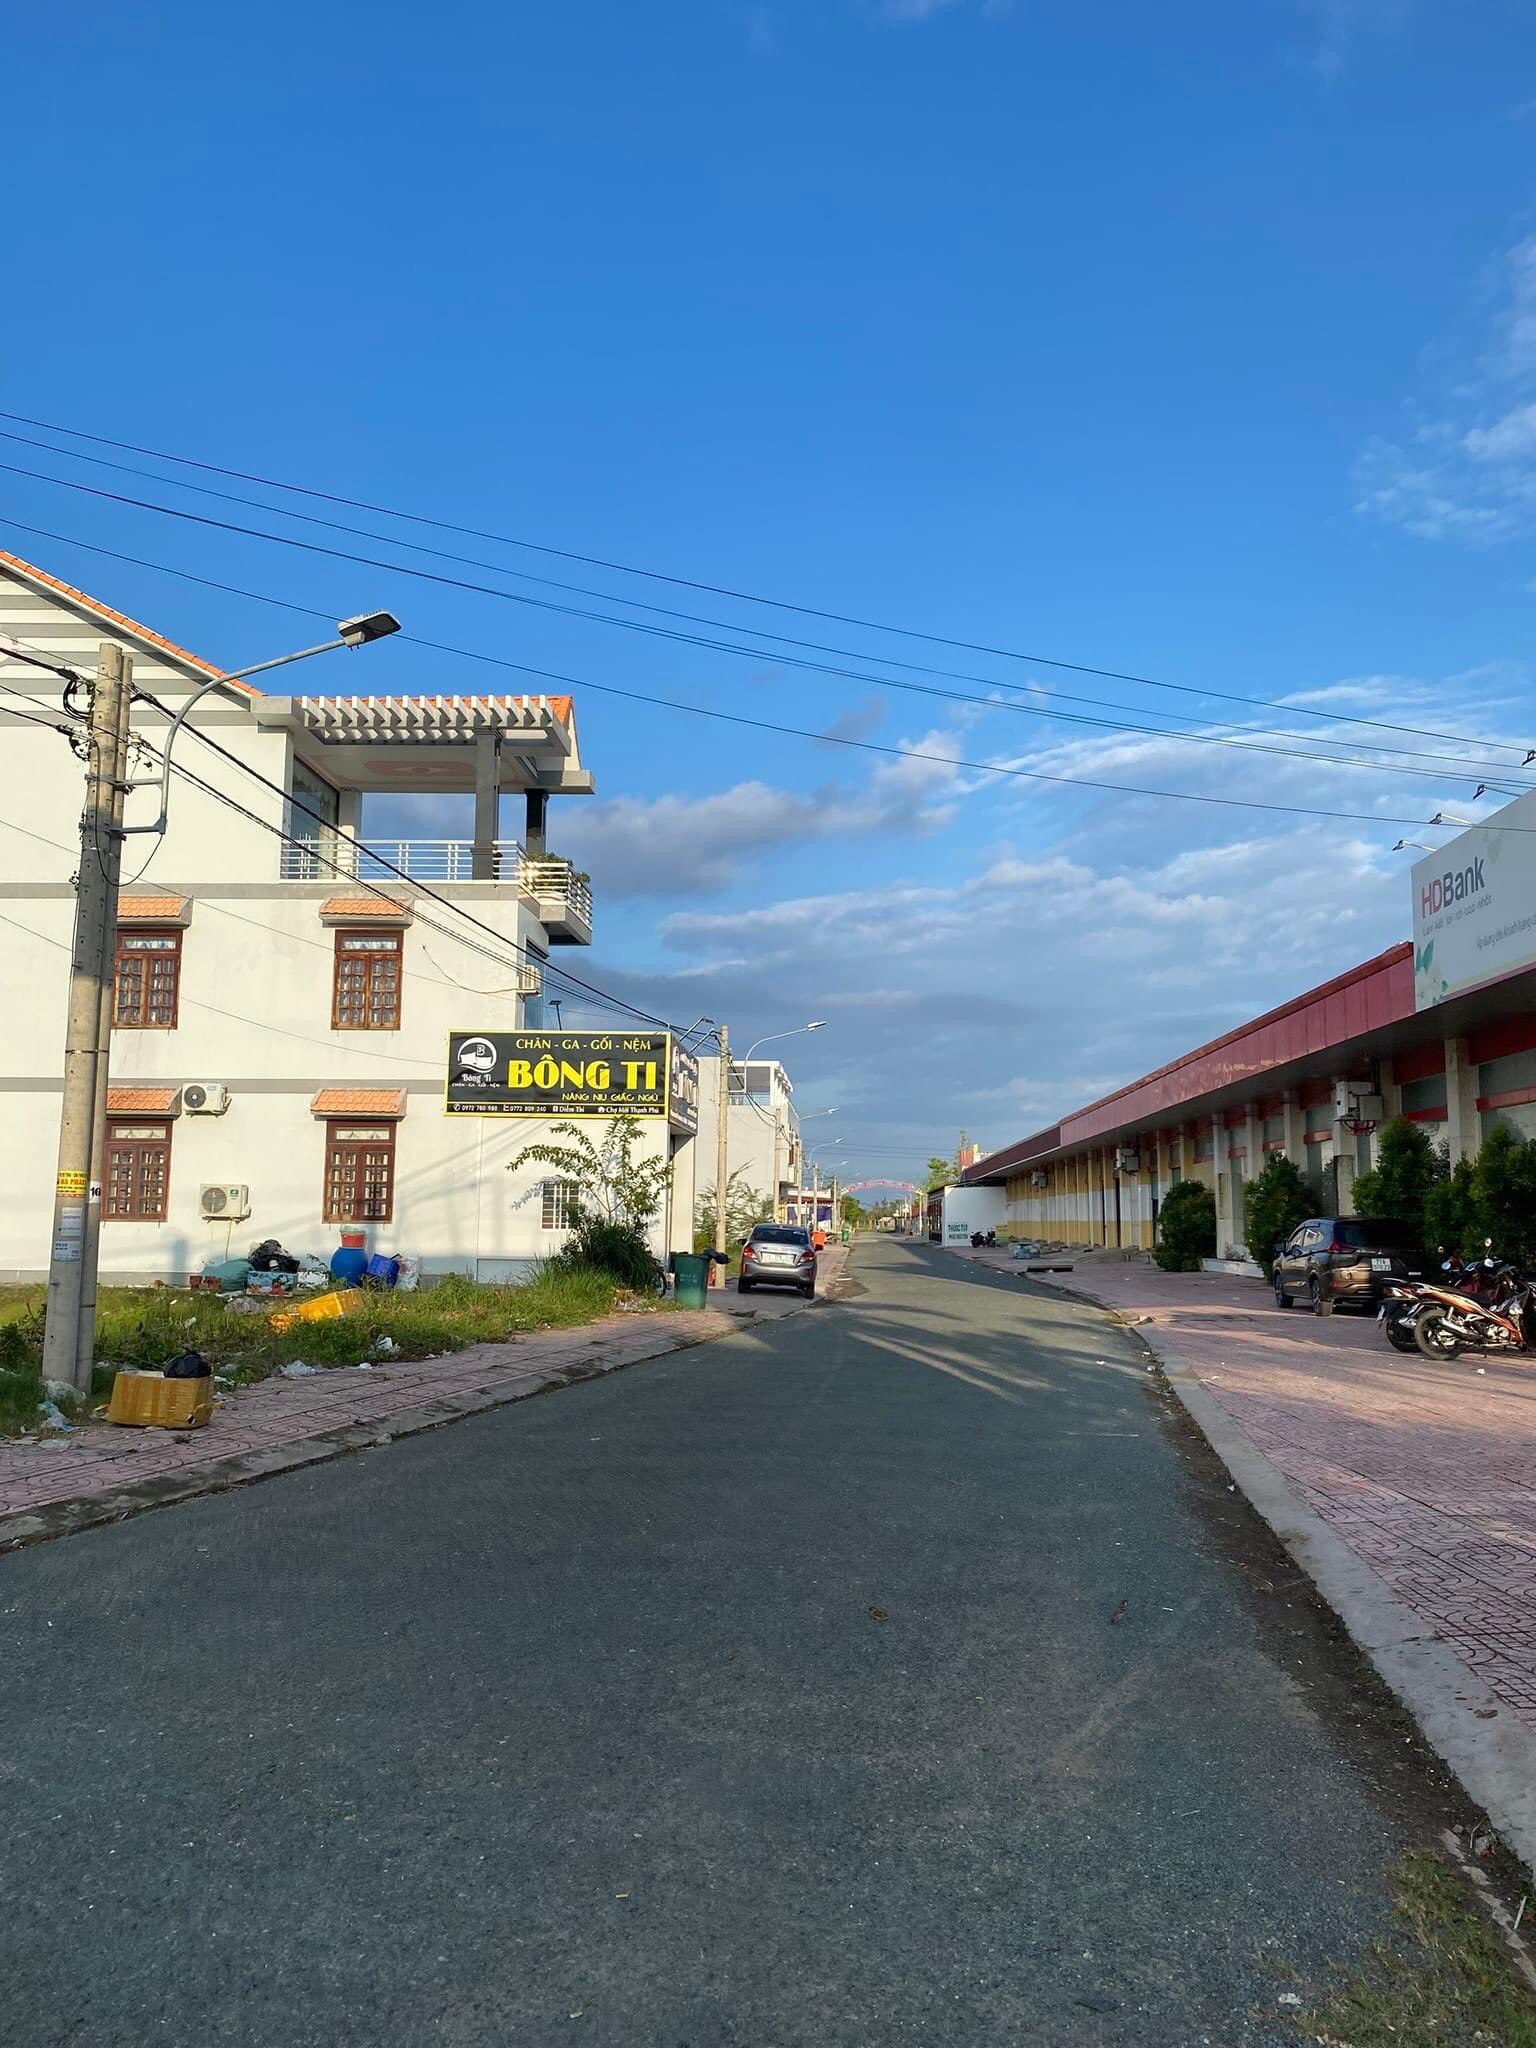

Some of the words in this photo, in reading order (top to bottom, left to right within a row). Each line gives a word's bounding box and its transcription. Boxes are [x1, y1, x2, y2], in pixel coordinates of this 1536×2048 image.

[1421, 856, 1485, 919] HDBank
[562, 1039, 580, 1050] GA
[590, 1036, 612, 1050] GỐI
[623, 1038, 651, 1052] NỆM
[508, 1053, 610, 1089] BÔNG
[620, 1061, 657, 1089] TI
